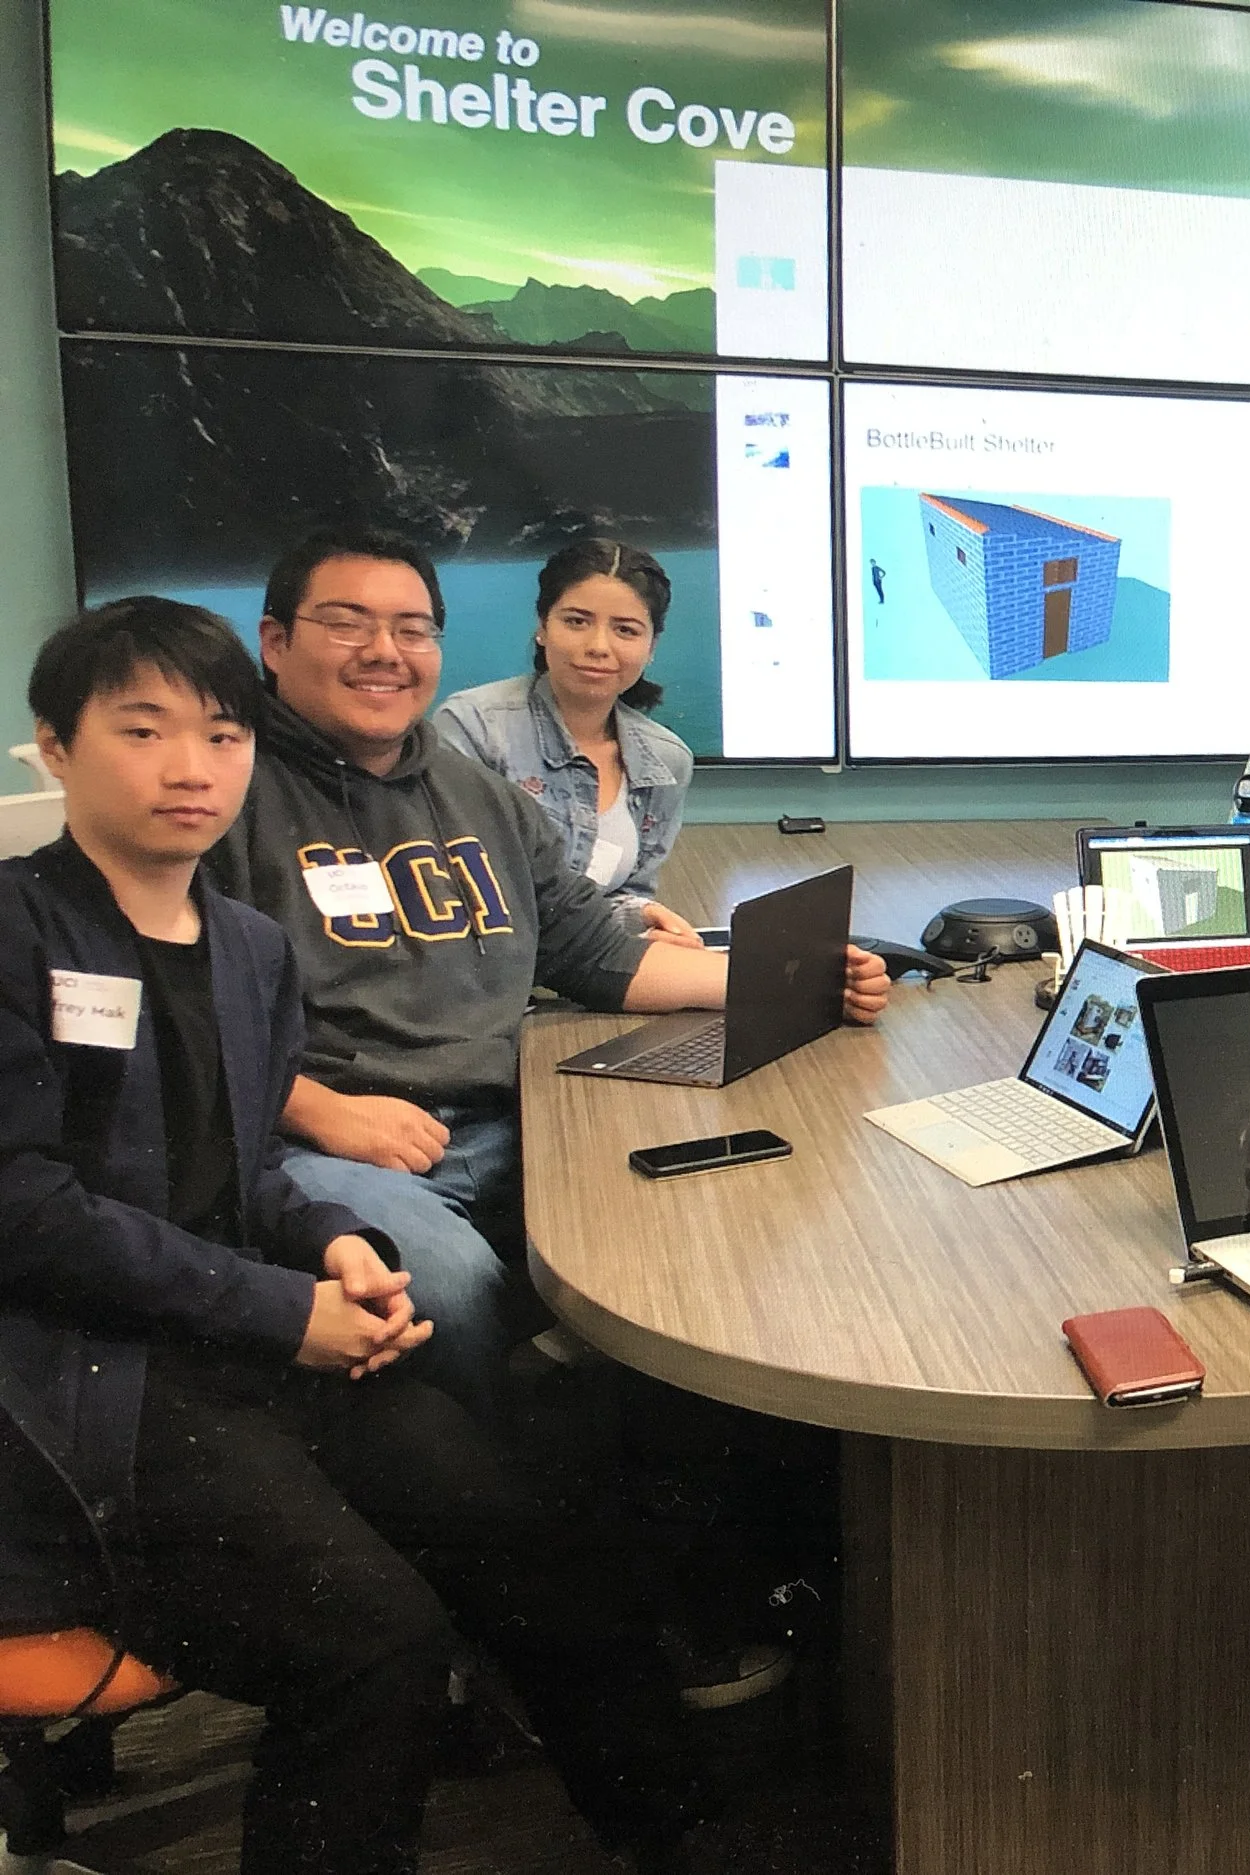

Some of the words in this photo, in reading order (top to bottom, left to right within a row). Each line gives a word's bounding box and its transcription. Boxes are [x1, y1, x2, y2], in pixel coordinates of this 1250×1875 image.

[281, 5, 484, 61] Welcome
[496, 30, 540, 68] to
[351, 58, 606, 138] Shelter
[626, 86, 796, 155] Cove
[983, 432, 1056, 454] Shelter
[298, 835, 514, 949] UCI
